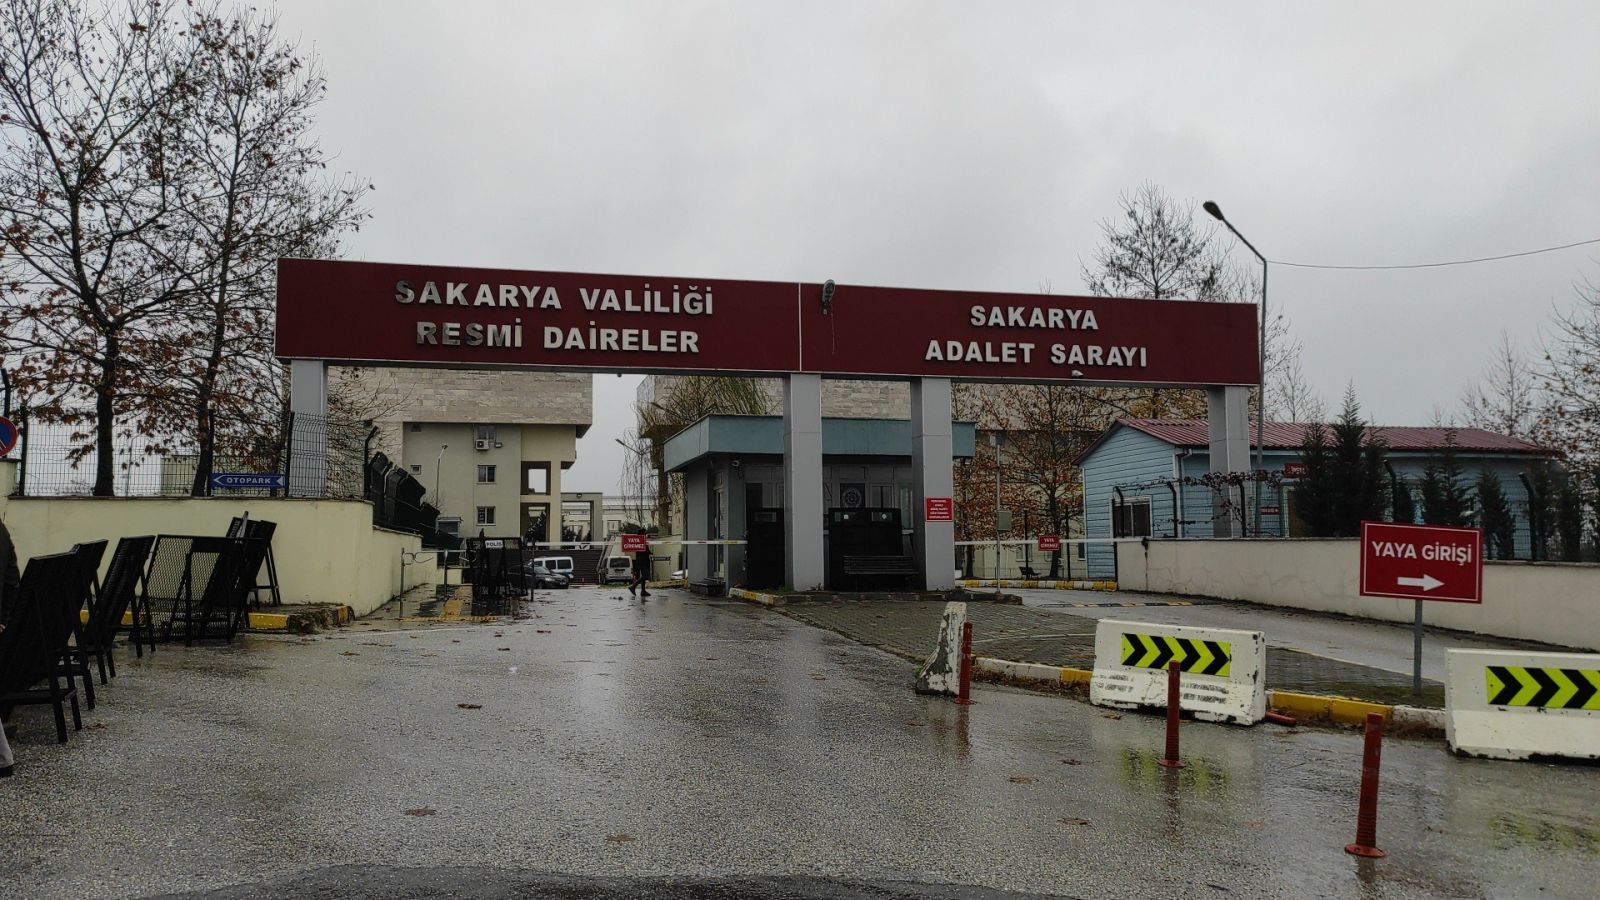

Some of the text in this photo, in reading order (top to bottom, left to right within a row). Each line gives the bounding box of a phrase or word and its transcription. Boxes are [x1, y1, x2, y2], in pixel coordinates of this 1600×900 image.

[395, 280, 713, 315] SAKARYA VALİLİĞİ
[970, 305, 1099, 330] SAKARYA
[416, 318, 699, 353] RESMİ DAİRELER
[925, 340, 1147, 368] ADALET SARAYI
[1372, 541, 1472, 566] YAYA GİRİŞİ
